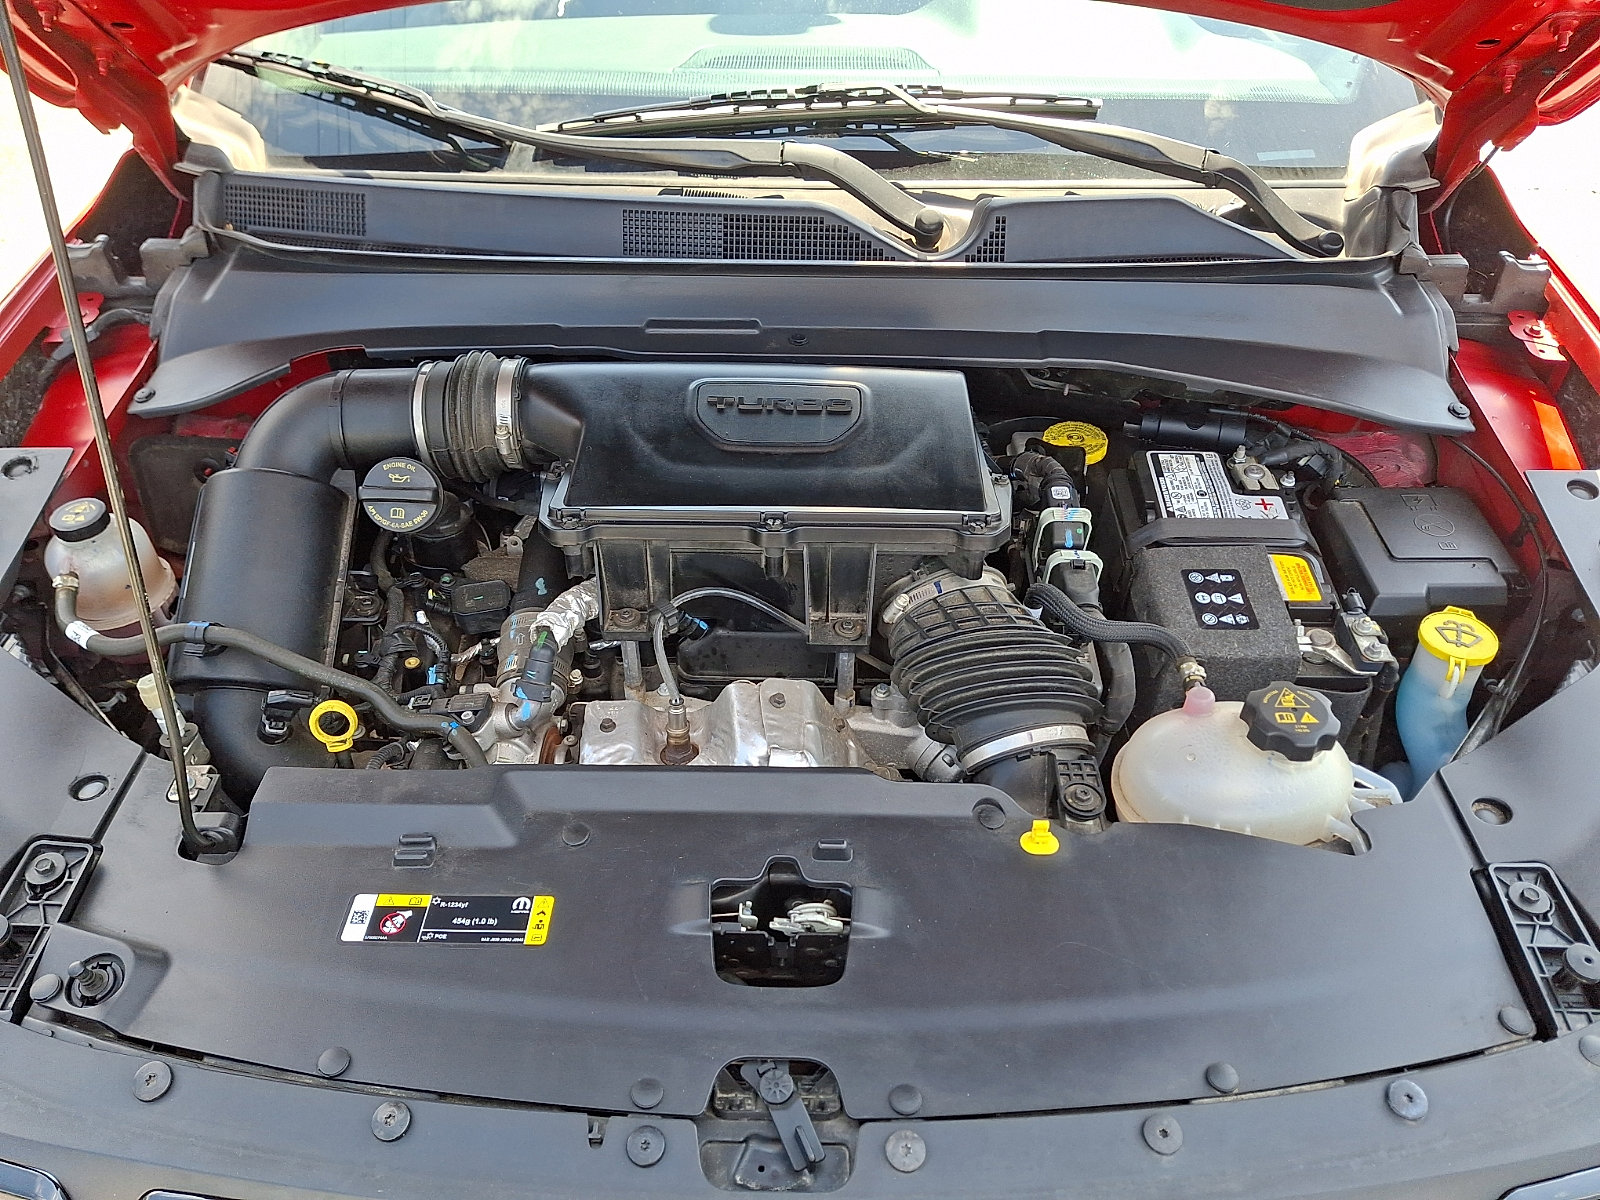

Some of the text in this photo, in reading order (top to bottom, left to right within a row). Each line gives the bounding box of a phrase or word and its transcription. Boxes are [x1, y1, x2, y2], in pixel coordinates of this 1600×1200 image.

[707, 395, 852, 415] TURBO
[383, 461, 416, 473] ENGINE OIL
[451, 917, 498, 926] 454g (1.0 lb)
